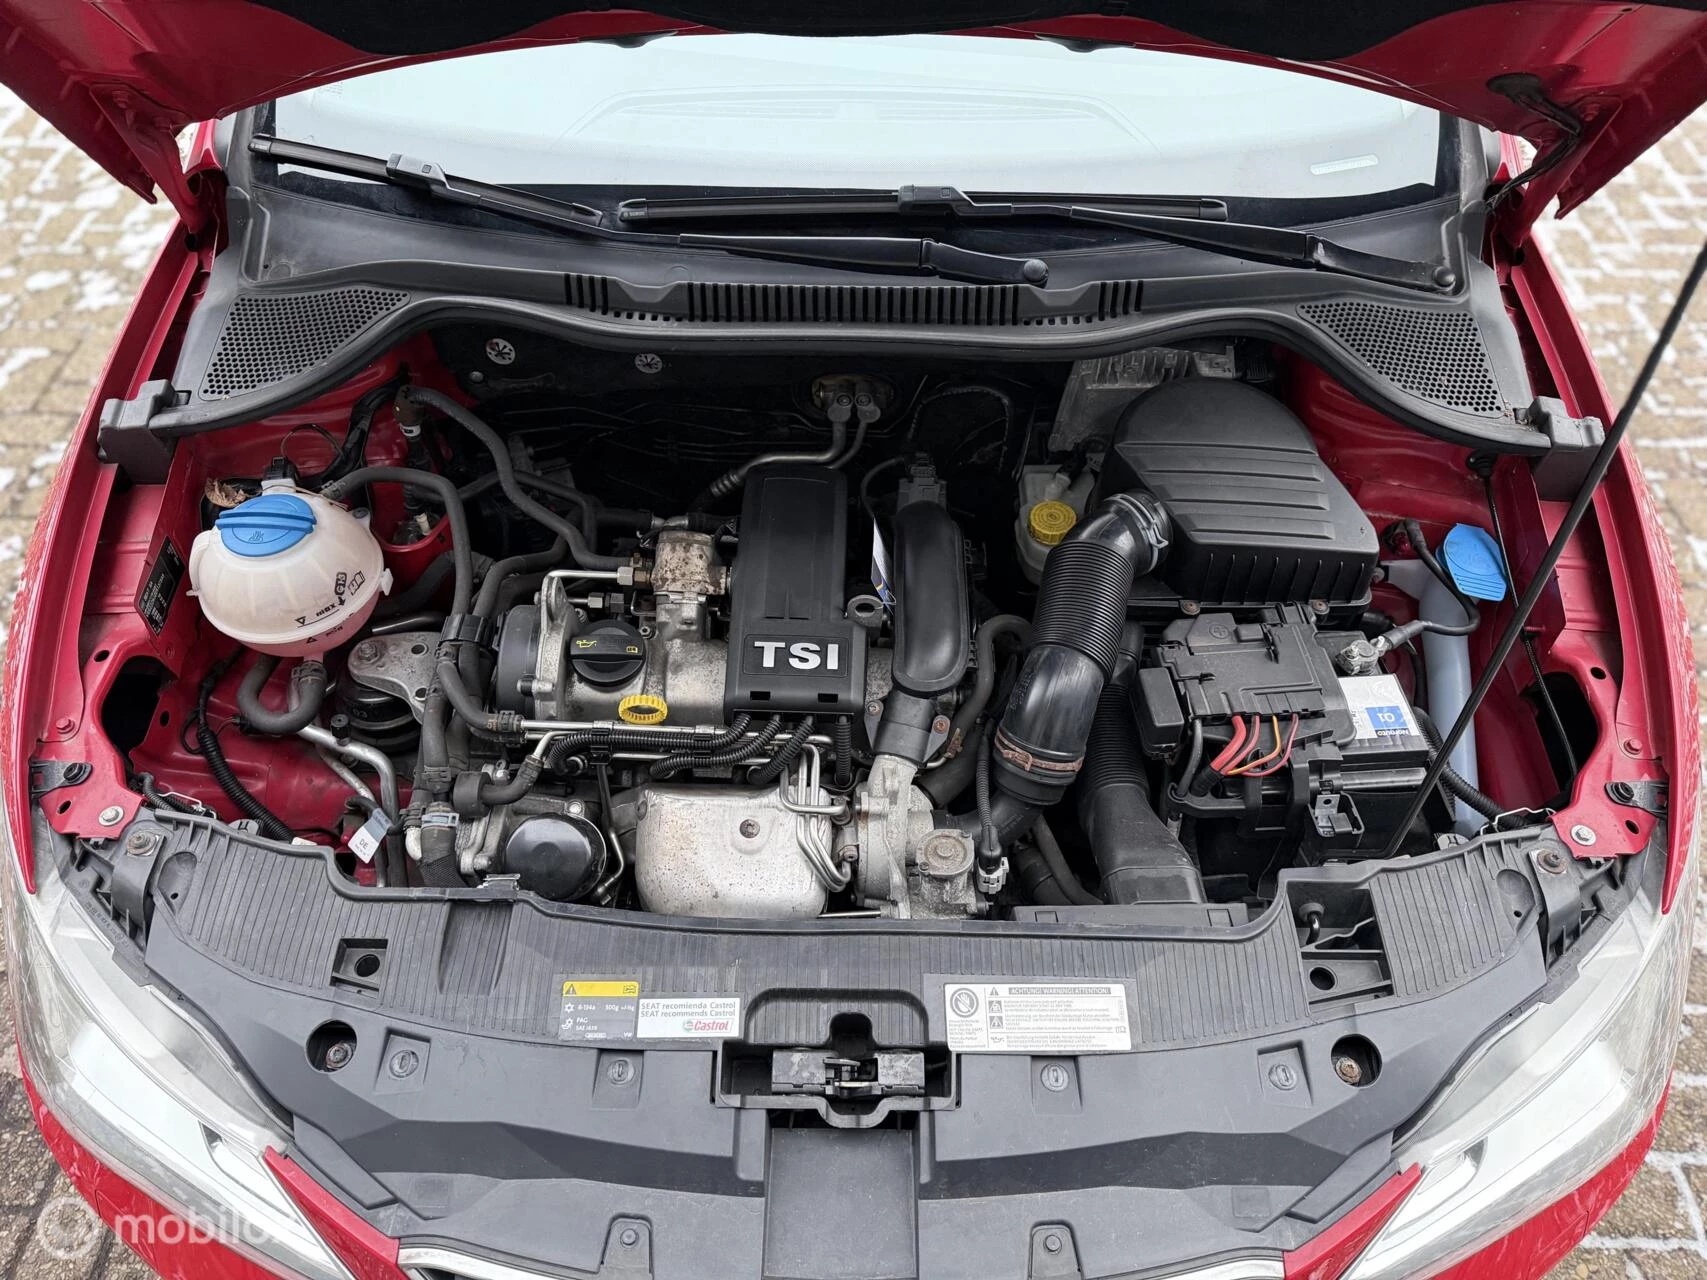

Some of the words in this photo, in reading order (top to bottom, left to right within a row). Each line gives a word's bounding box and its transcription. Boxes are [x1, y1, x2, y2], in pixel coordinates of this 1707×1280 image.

[316, 603, 336, 616] max
[754, 641, 839, 670] TSI
[641, 1002, 660, 1010] SEAT
[662, 1001, 707, 1009] recomienda
[709, 1001, 736, 1009] Castrol
[661, 1009, 708, 1017] recommends
[709, 1009, 736, 1017] Castrol
[694, 1020, 729, 1031] Castrol
